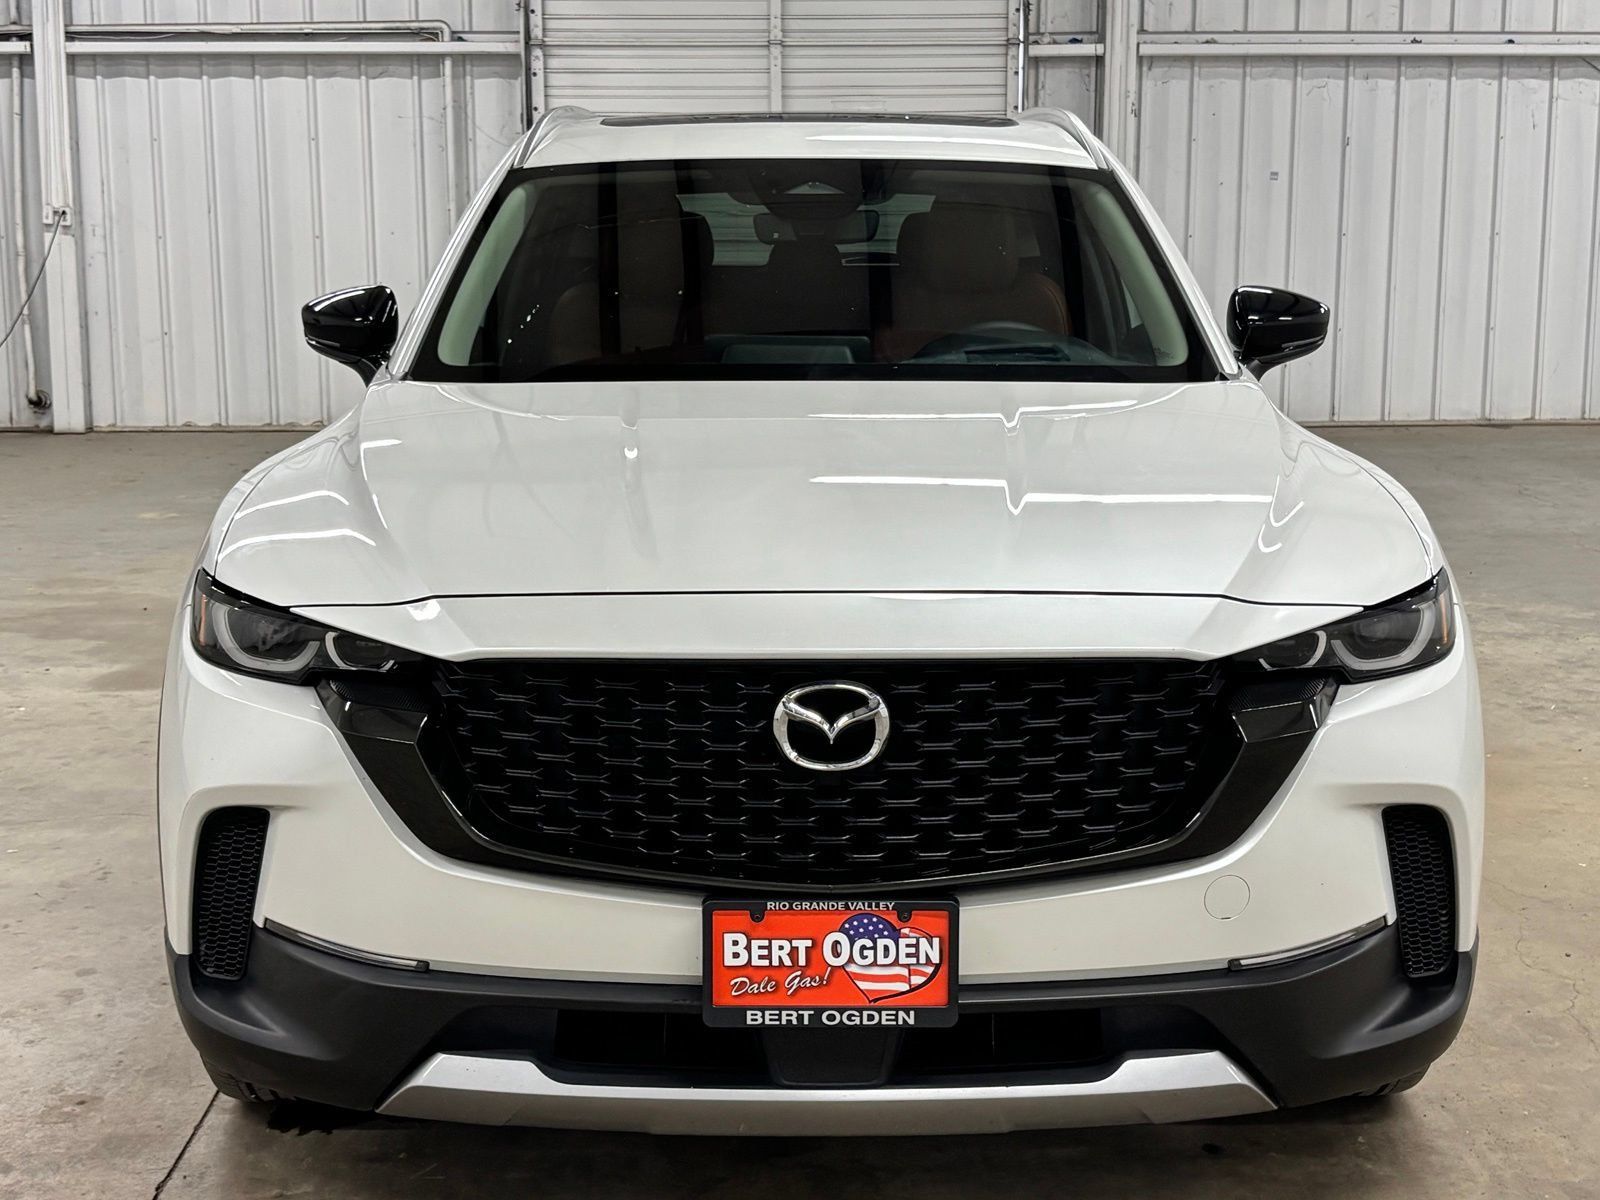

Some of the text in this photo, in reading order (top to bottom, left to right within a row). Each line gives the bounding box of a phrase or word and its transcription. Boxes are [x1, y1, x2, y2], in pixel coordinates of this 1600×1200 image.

[767, 902, 895, 911] RIO GRANDE VALLEY
[730, 967, 831, 996] Dale Gas!
[746, 1010, 915, 1025] BERT OGDEN
